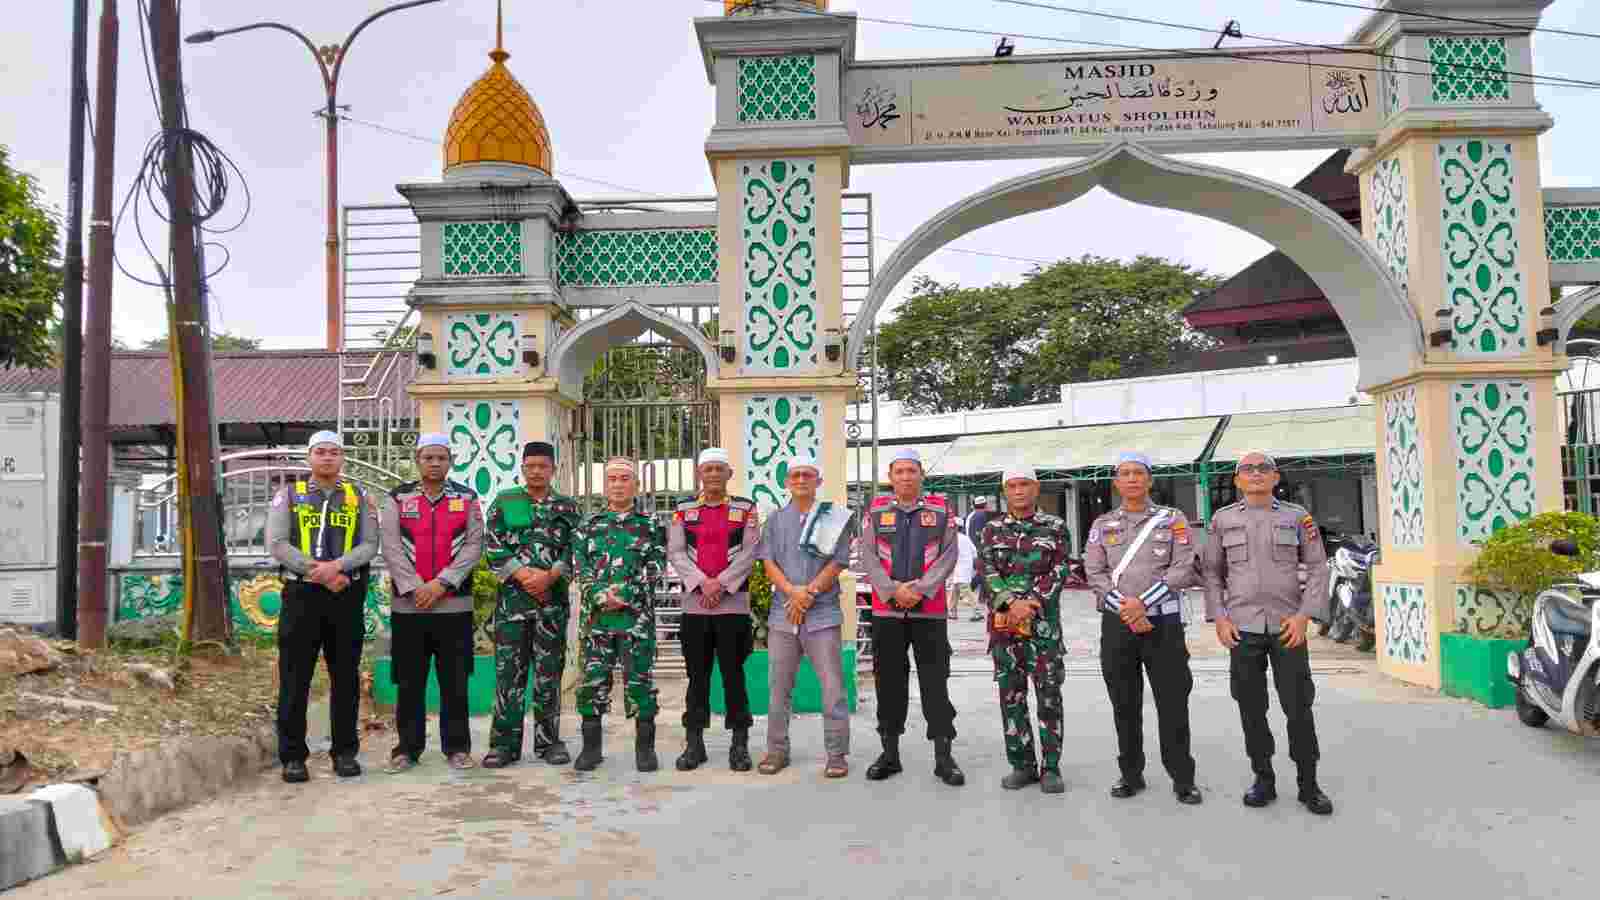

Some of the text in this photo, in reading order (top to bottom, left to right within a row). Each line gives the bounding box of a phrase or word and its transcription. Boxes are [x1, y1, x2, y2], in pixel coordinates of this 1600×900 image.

[1064, 64, 1155, 79] MASJID
[1008, 110, 1216, 125] WARDATUS SHOLIHIN
